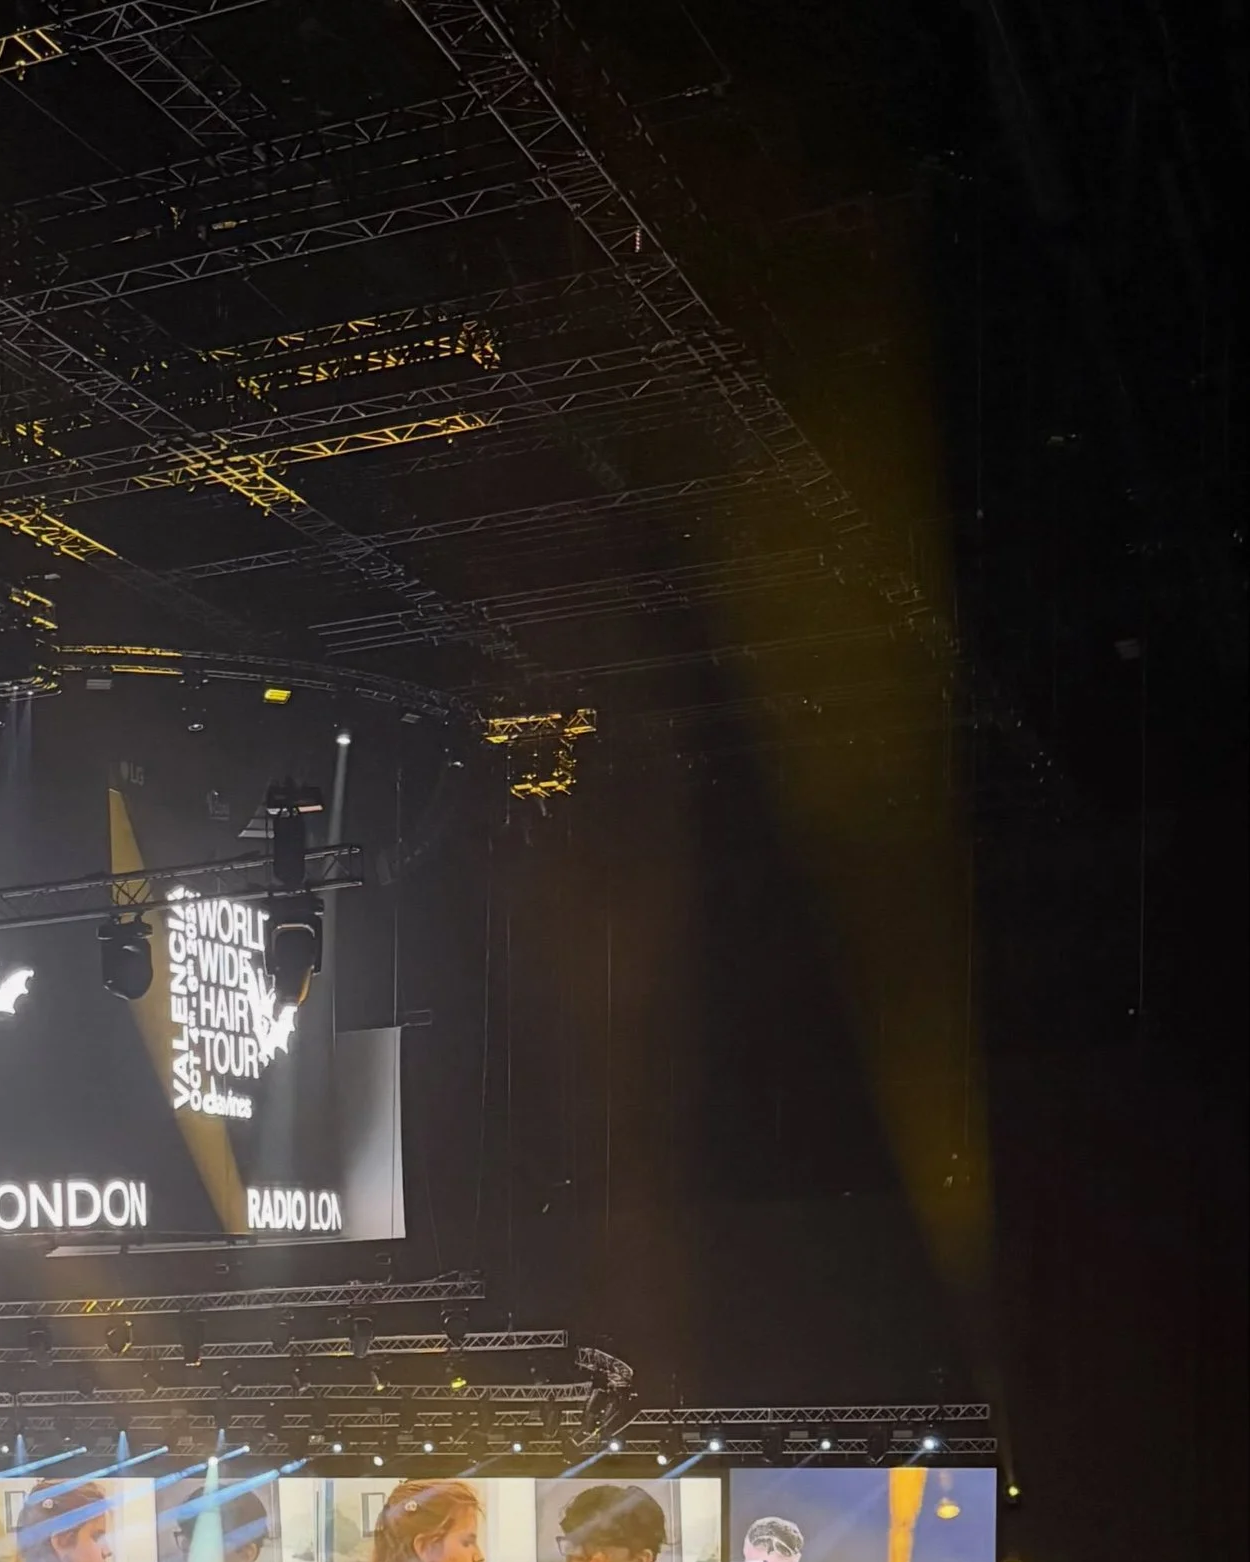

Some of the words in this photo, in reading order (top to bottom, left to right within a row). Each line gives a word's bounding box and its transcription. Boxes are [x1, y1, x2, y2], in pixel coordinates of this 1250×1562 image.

[166, 887, 191, 1110] VALENCIA
[200, 983, 251, 1035] HAIR
[200, 1030, 259, 1079] TOUR
[188, 1050, 202, 1112] OCT
[202, 1075, 252, 1119] davines
[247, 1188, 306, 1231] RADIO
